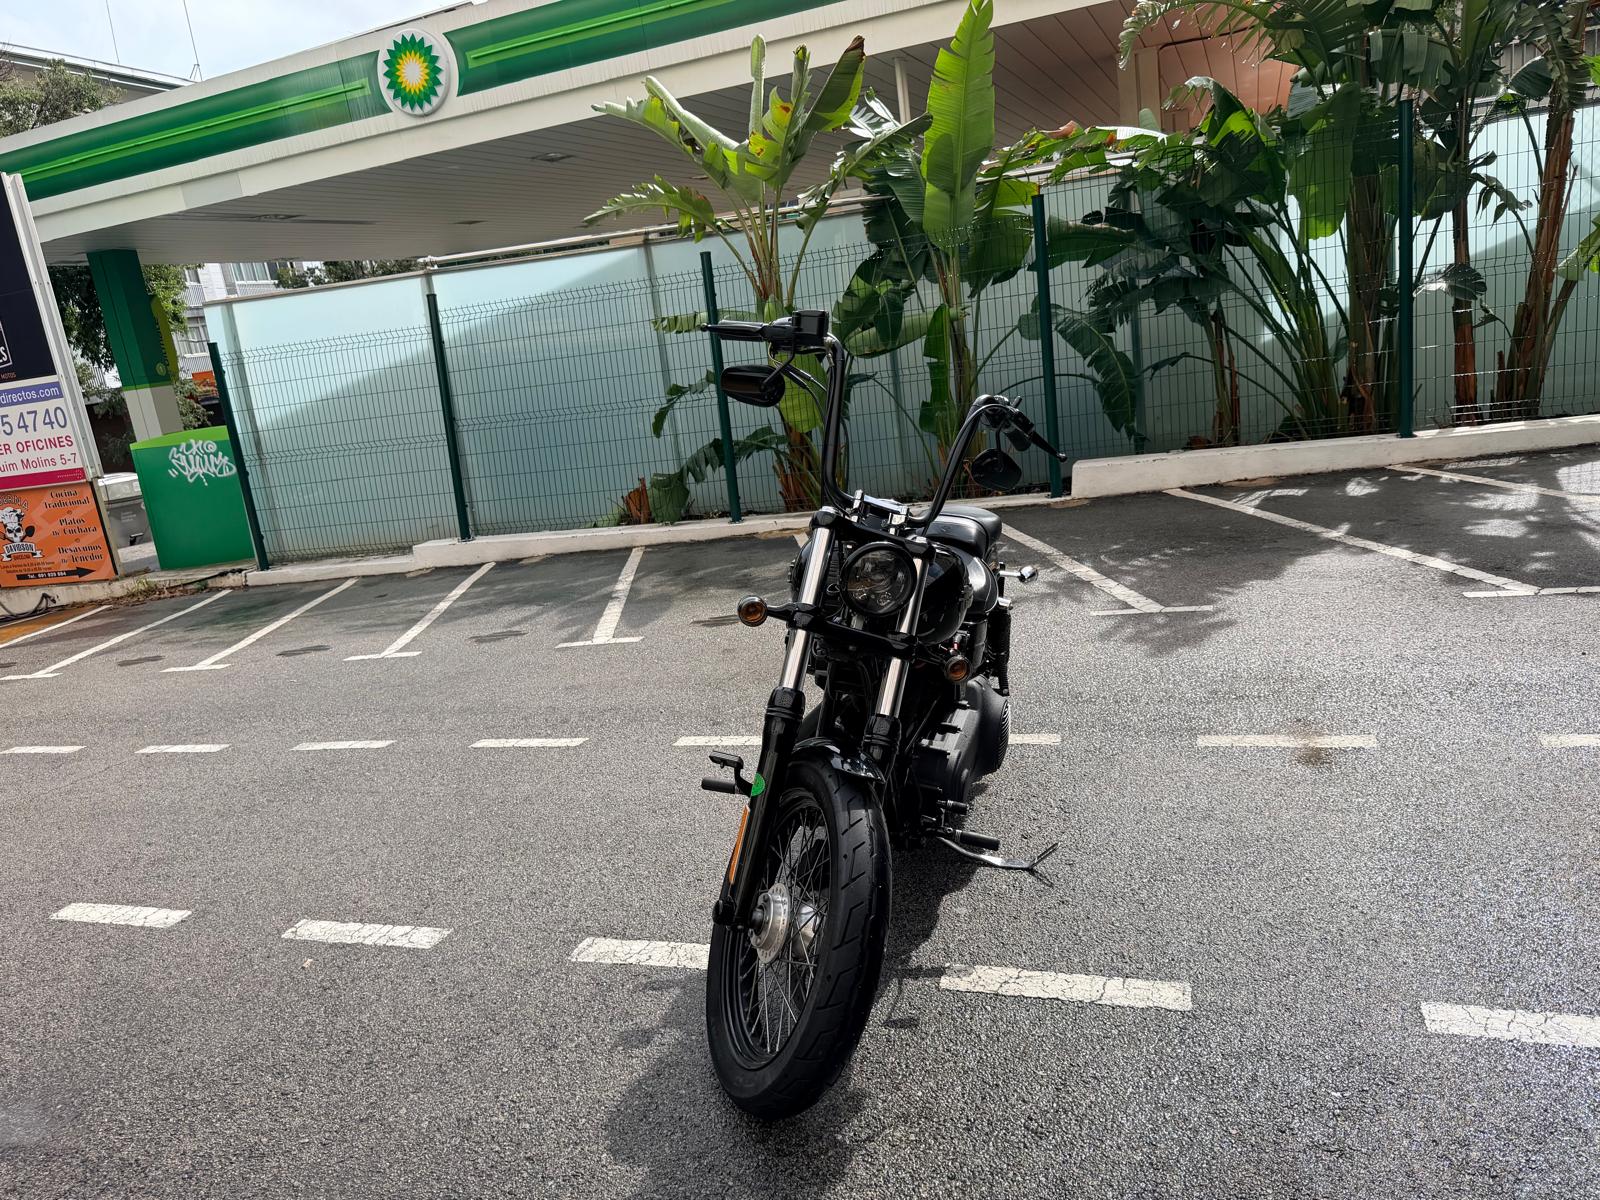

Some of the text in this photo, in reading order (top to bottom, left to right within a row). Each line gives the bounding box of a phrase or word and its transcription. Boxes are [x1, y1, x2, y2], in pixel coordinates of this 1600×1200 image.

[16, 435, 74, 453] OFICINES
[20, 457, 57, 471] Molins
[59, 452, 77, 466] 5-7
[50, 489, 78, 498] Cocina
[44, 496, 90, 509] Tradicional
[59, 517, 85, 526] Platos
[63, 525, 97, 536] Cuchara
[5, 543, 34, 553] DAVIDSON
[58, 544, 101, 554] Desayunos
[71, 552, 103, 563] Tenedor
